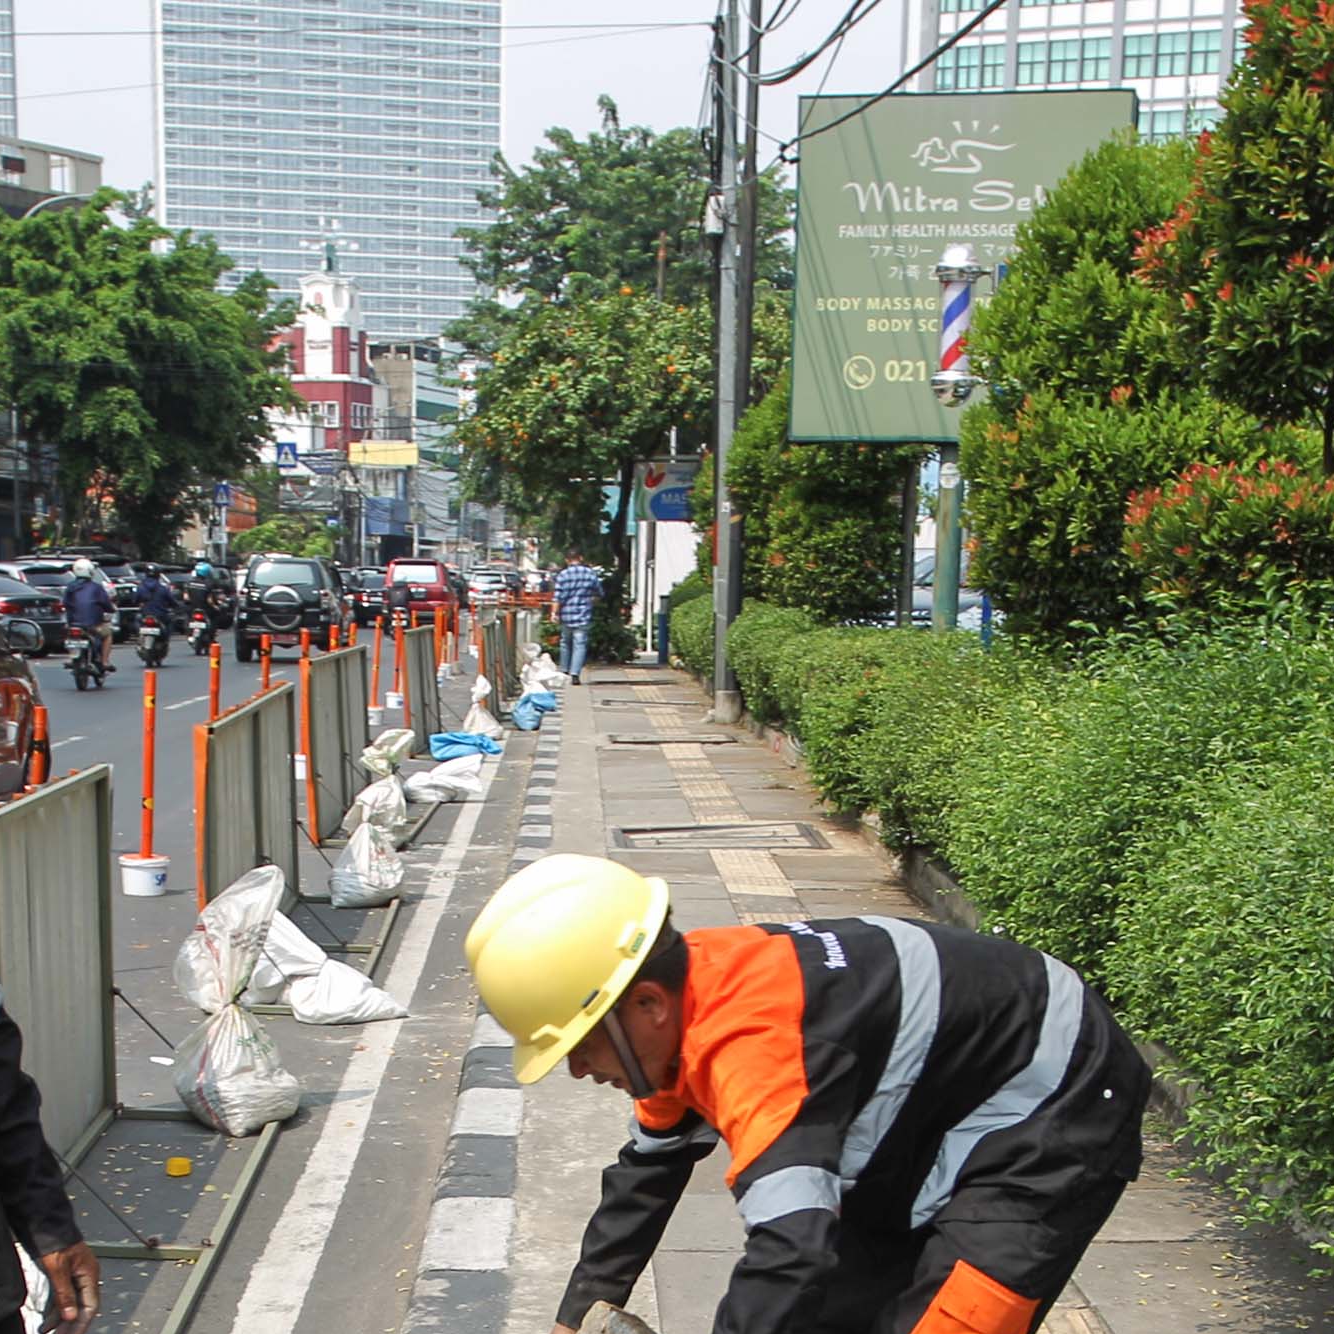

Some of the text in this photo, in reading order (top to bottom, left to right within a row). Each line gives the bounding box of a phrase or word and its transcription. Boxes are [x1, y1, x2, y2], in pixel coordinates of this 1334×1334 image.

[843, 181, 959, 213] Mitra
[838, 223, 1017, 239] FAMILY HEALTH MASSAGE
[817, 296, 937, 311] BODY MASSAG
[867, 318, 913, 332] BODY
[884, 360, 927, 382] 021
